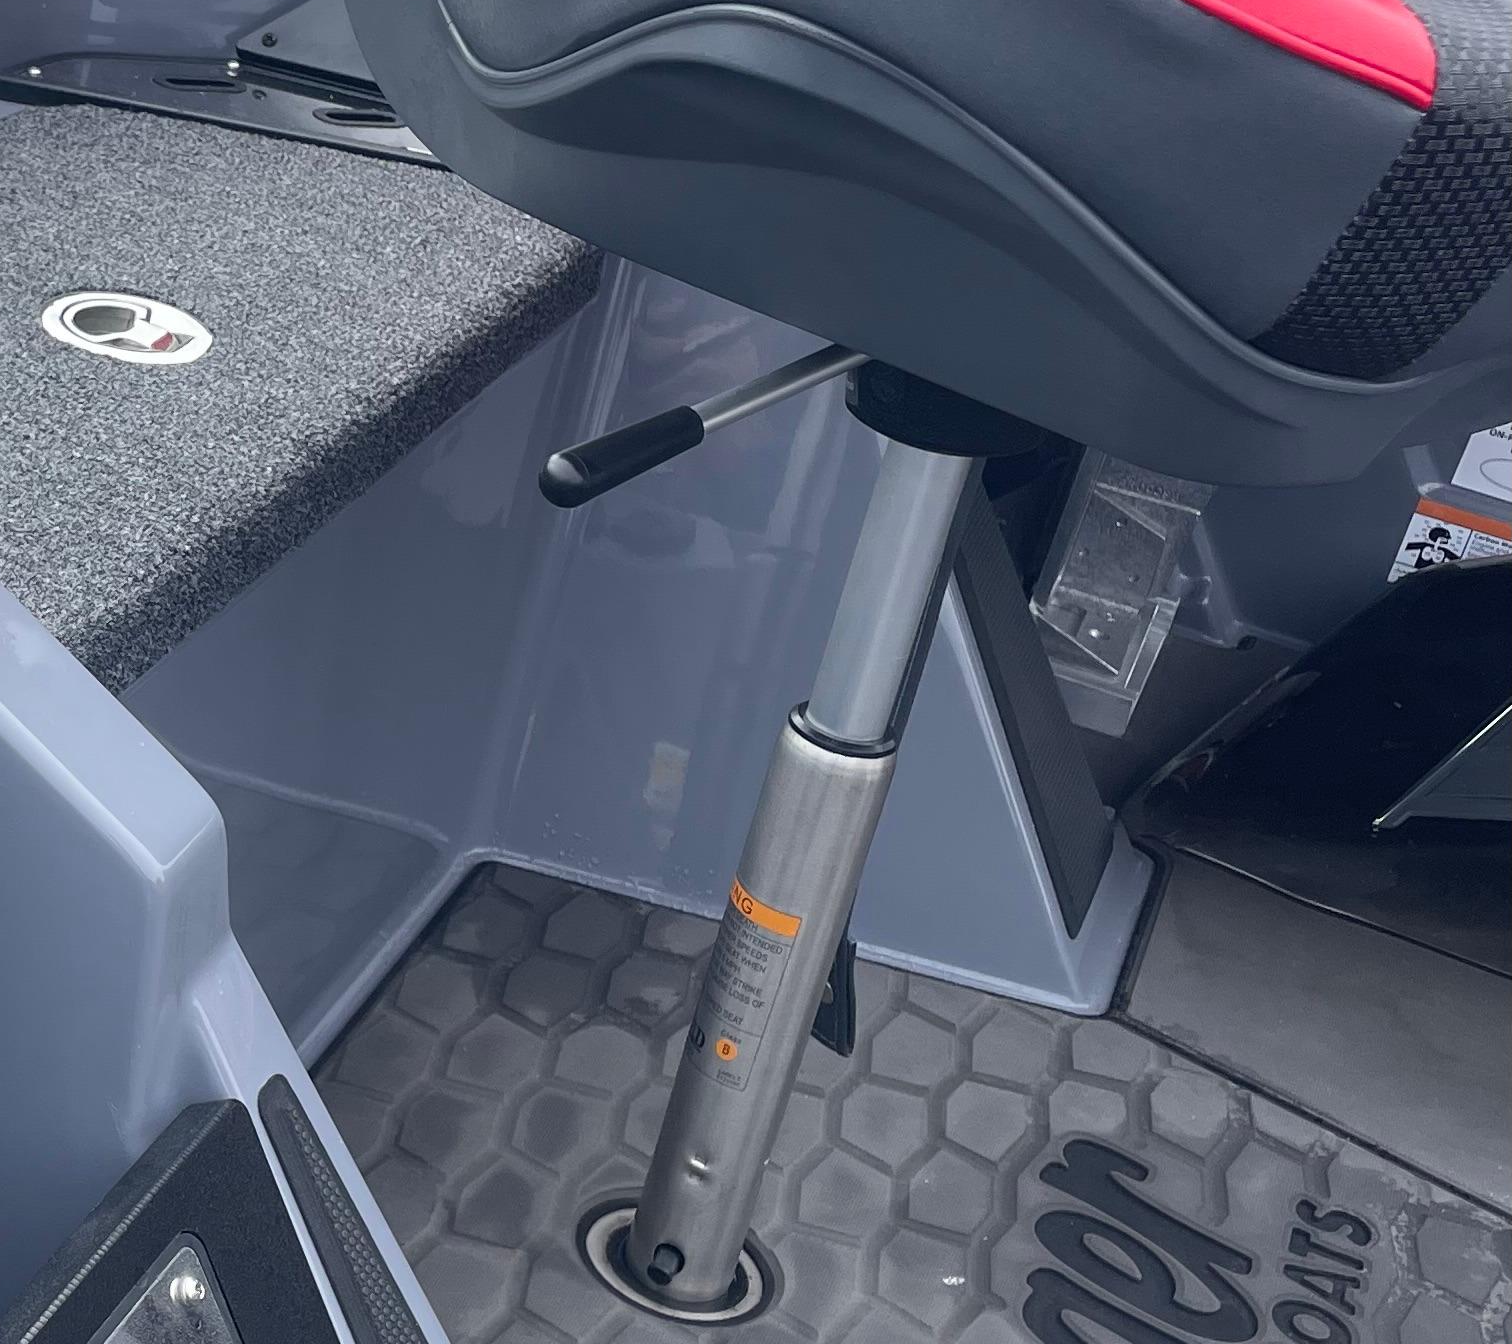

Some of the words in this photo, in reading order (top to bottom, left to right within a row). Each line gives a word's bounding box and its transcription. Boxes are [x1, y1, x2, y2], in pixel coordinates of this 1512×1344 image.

[737, 939, 768, 962] SPEEDS
[742, 929, 784, 955] INTENDED
[751, 999, 766, 1009] OF
